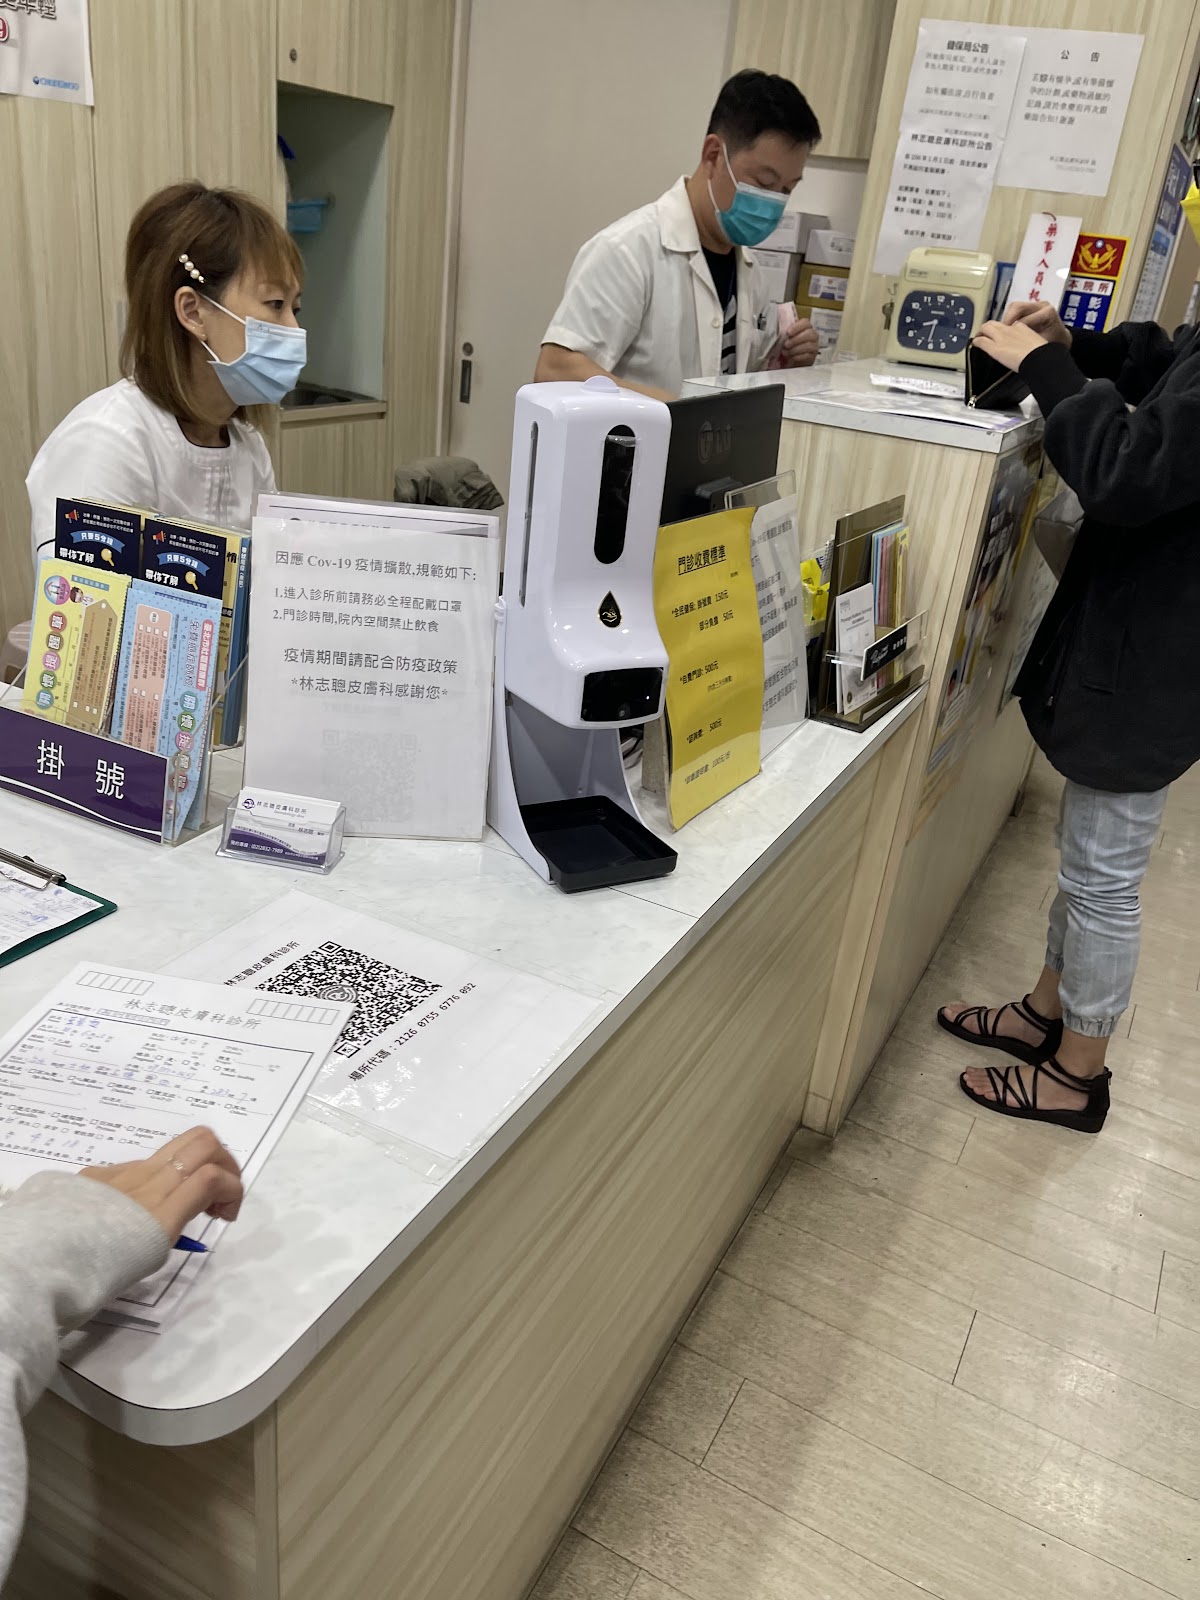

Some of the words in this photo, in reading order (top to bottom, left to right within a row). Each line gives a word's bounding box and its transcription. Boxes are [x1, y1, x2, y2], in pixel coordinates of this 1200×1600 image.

[1068, 279, 1110, 293] 本院所
[59, 547, 95, 564] 帶你了解
[275, 550, 304, 567] 因應
[307, 556, 352, 570] Cov-19
[355, 558, 478, 582] 疫情擴散,規範如下:
[678, 544, 726, 574] 門診收費標準
[145, 569, 179, 586] 帶你了解
[274, 587, 463, 613] 1.進入診所前請務必全程配戴口罩
[273, 609, 440, 633] 2.門診時間,院內空間禁止飲食
[283, 648, 458, 675] 疫情期間請配合防疫政策
[37, 739, 126, 800] 掛號
[223, 940, 300, 986] 林志聰皮膚科診所
[124, 998, 262, 1030] 林志聰皮膚科診所
[393, 1029, 417, 1047] 2126
[416, 1010, 440, 1029] 0755
[438, 996, 462, 1012] 6776
[459, 982, 477, 995] 092
